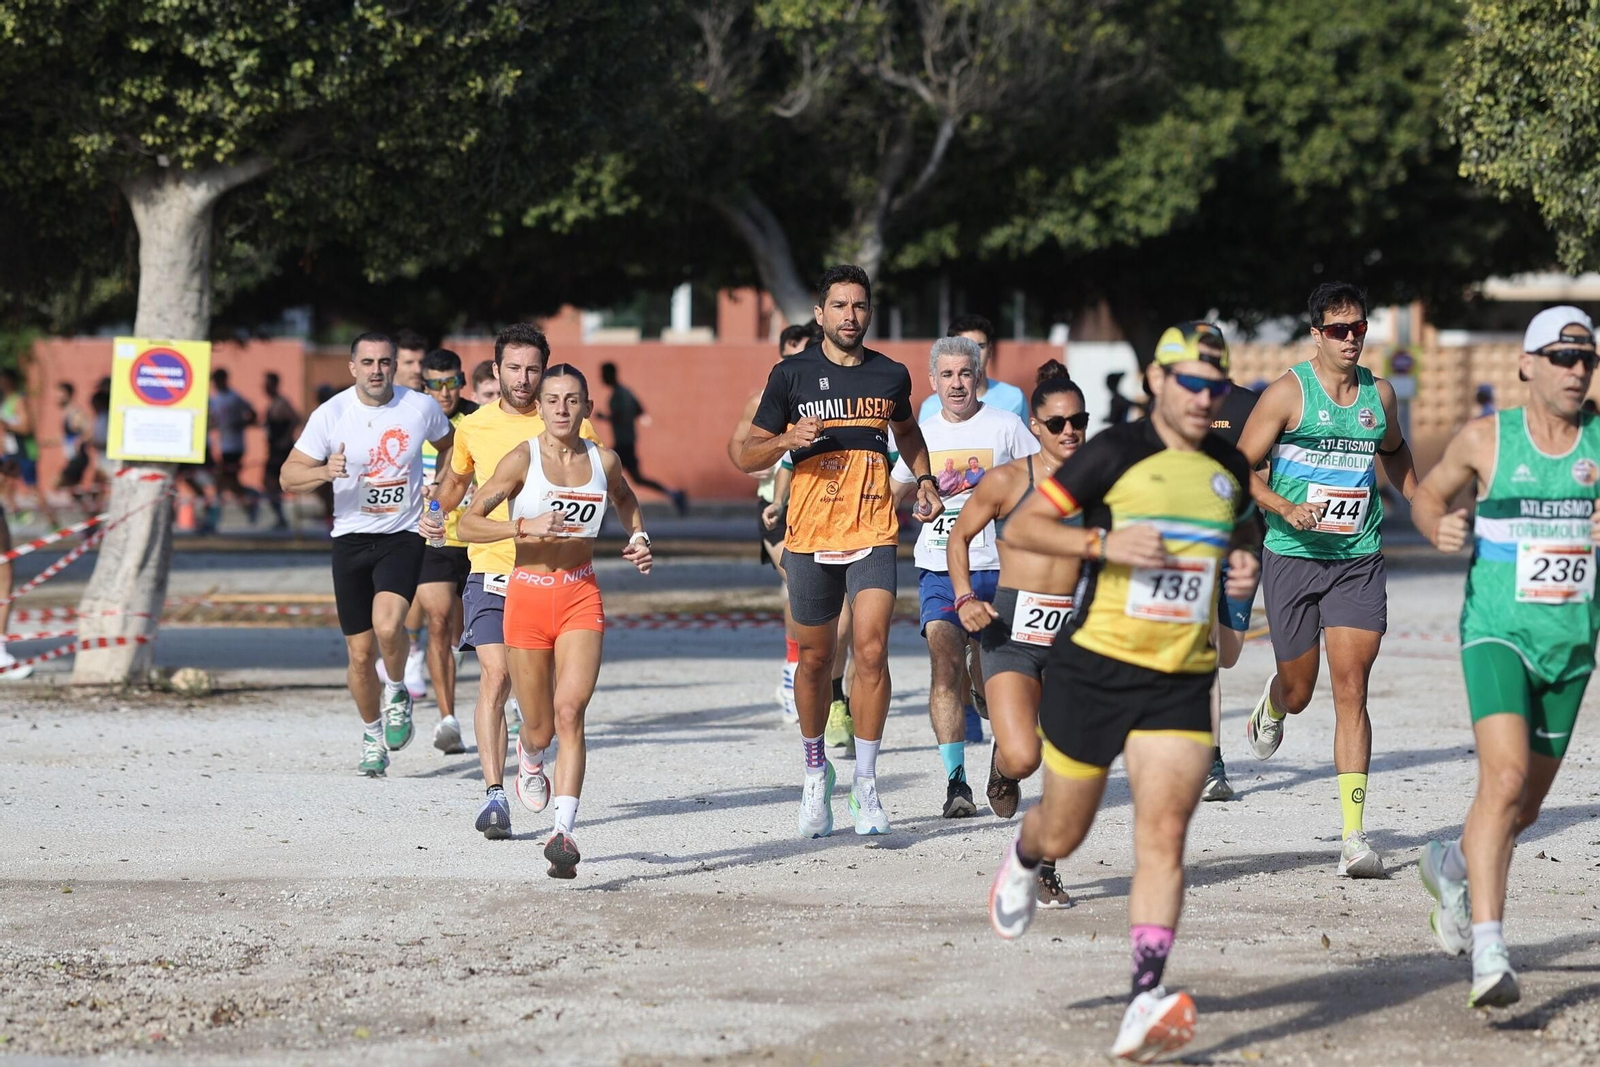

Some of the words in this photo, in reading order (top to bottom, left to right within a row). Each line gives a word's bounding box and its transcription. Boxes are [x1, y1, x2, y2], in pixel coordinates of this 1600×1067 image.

[1317, 438, 1375, 453] ATLETISMO
[367, 486, 404, 504] 358
[1321, 499, 1360, 520] 144
[1520, 499, 1593, 517] ATLETISMO
[515, 571, 555, 586] PRO
[1530, 558, 1588, 583] 236
[1150, 573, 1202, 602] 138
